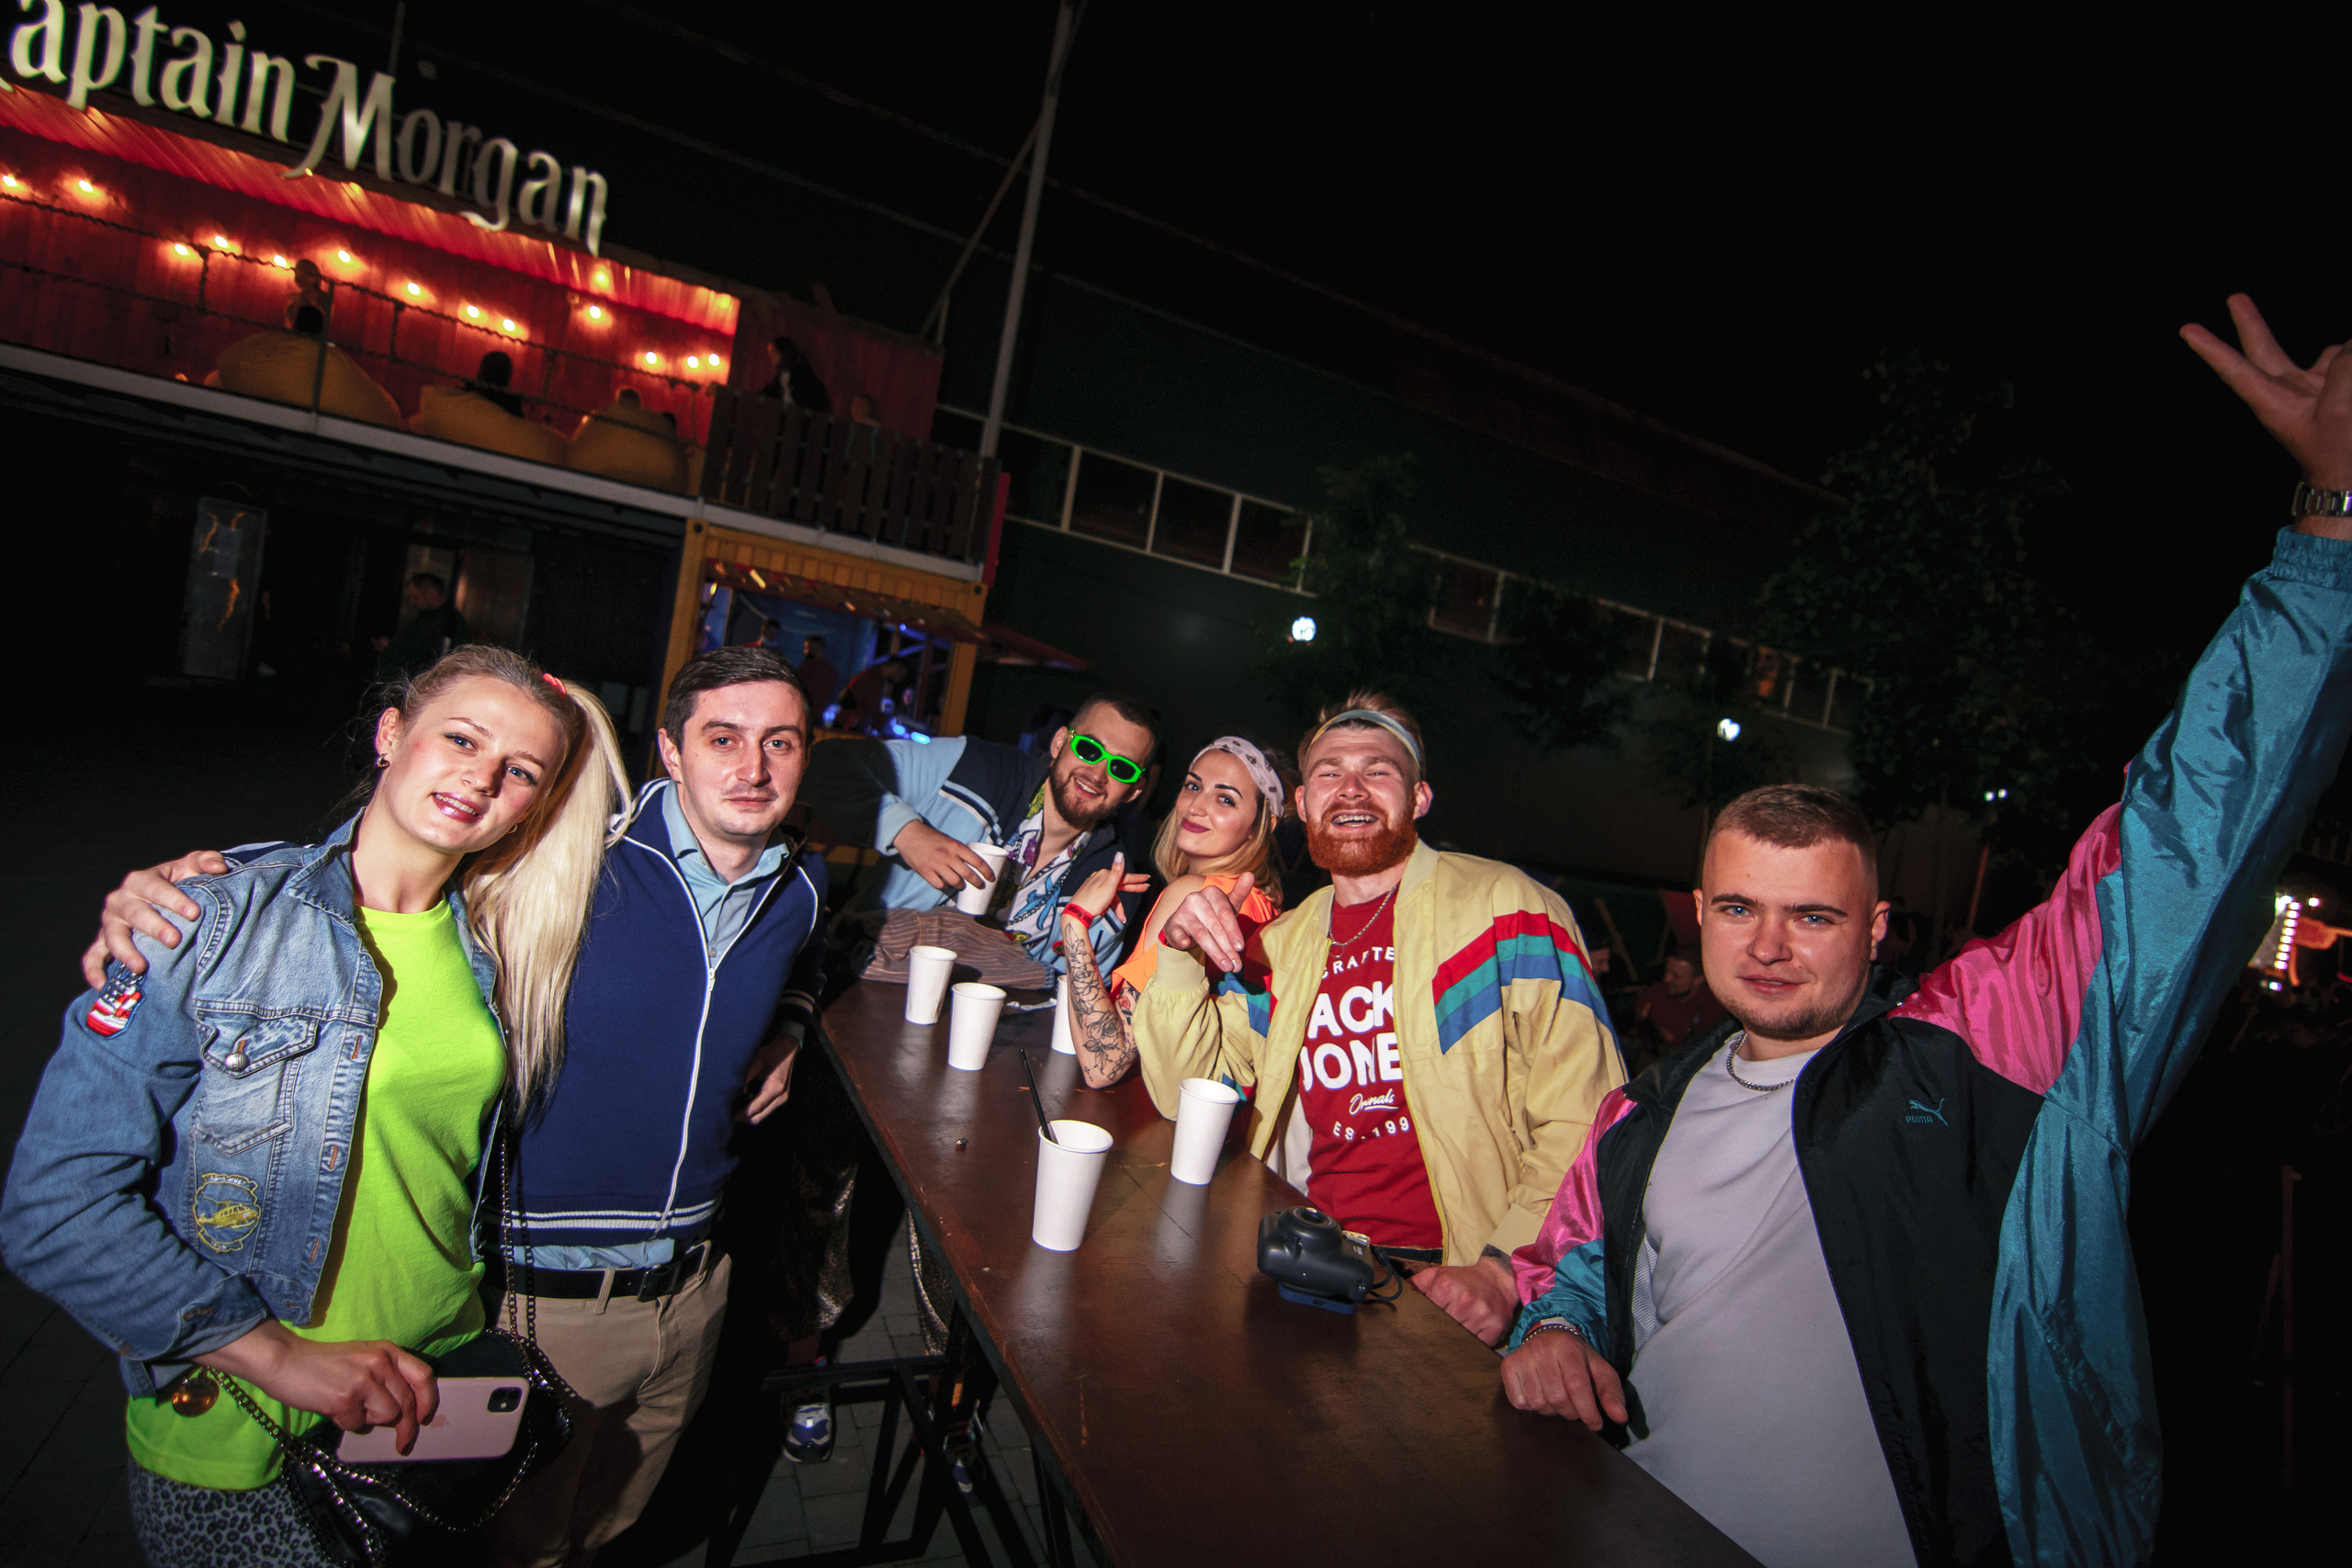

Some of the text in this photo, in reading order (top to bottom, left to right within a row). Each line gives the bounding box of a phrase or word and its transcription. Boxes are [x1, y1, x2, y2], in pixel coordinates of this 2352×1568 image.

[0, 0, 608, 258] aptain Morgan
[1307, 980, 1395, 1039] ACK
[1299, 1032, 1403, 1092] JONE
[1372, 1116, 1409, 1138] 199
[1905, 1115, 1934, 1123] PUMA
